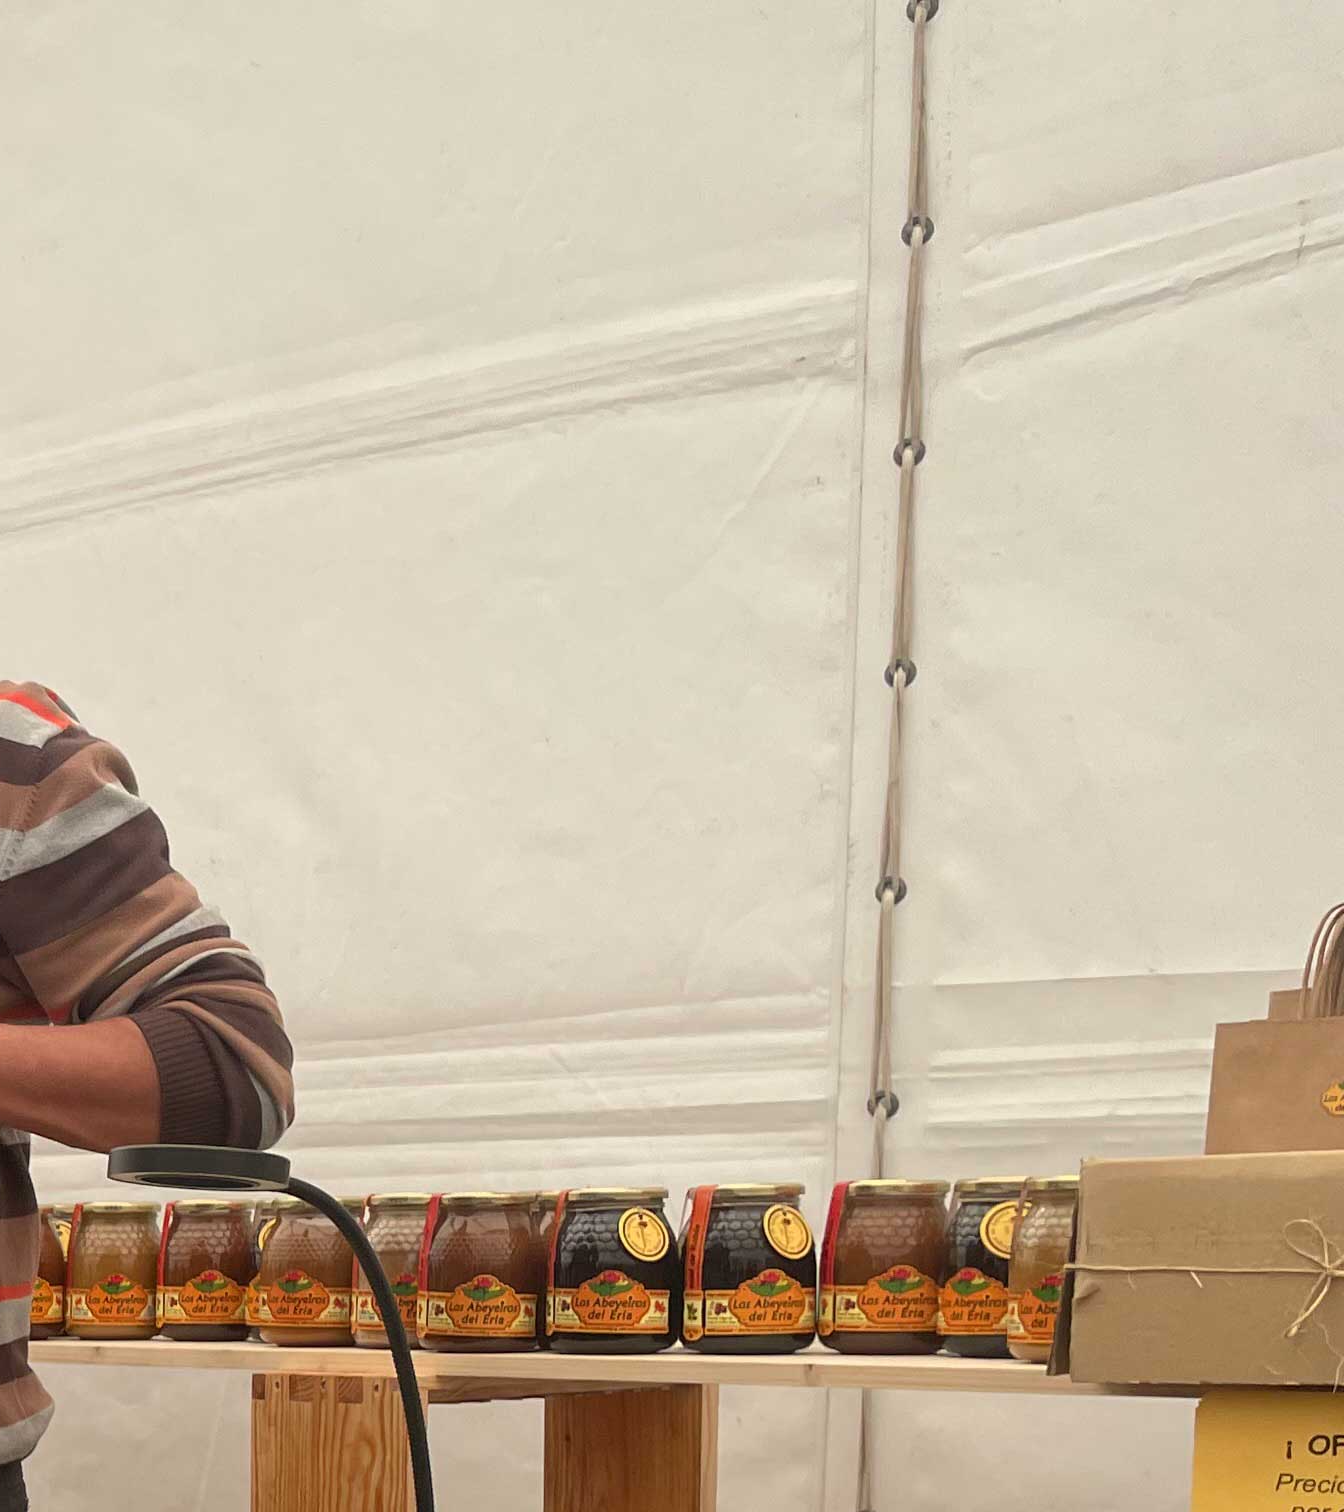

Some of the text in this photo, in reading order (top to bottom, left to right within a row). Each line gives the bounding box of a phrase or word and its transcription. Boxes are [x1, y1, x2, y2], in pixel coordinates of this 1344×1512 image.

[197, 1292, 240, 1305] Abeyeiros
[593, 1295, 647, 1310] Abeyeiros
[753, 1296, 804, 1311] Abeyeiros
[881, 1293, 936, 1309] Abeyeiros
[467, 1299, 518, 1315] Abeyeiros
